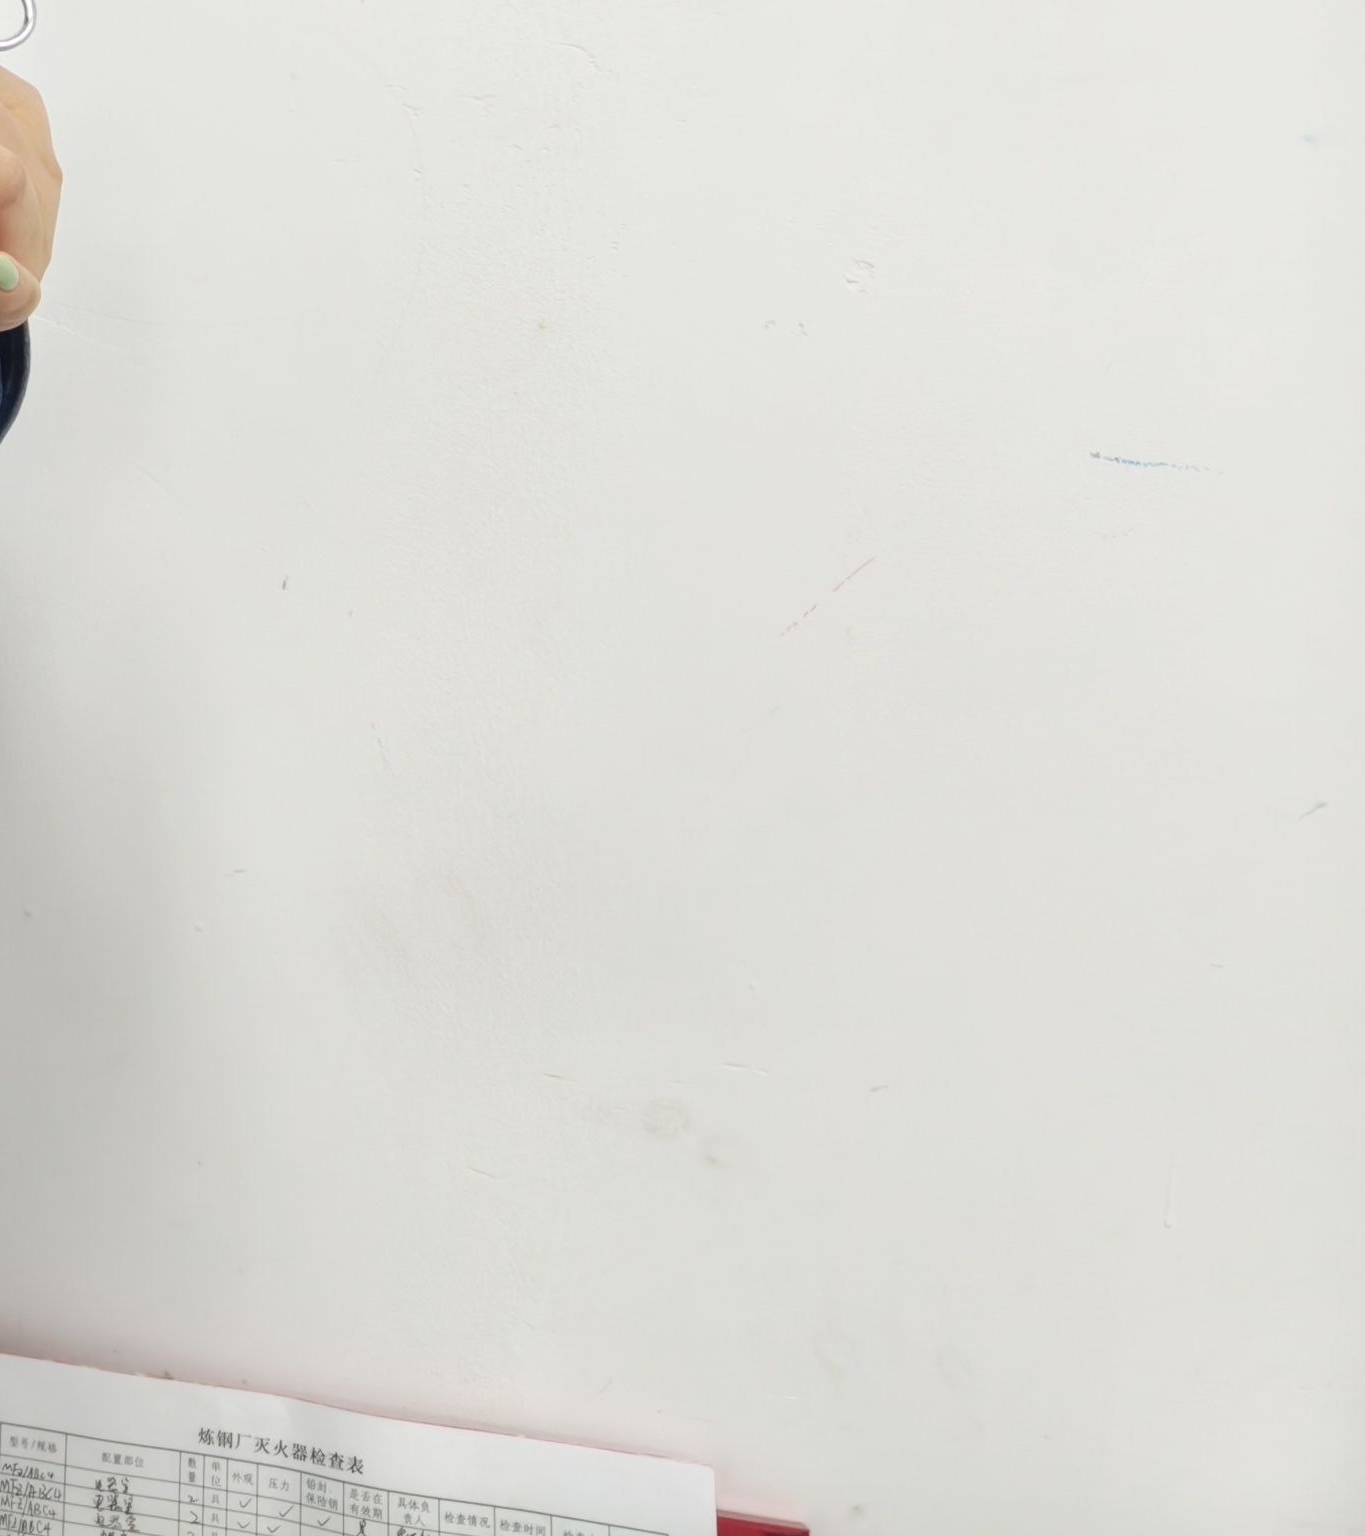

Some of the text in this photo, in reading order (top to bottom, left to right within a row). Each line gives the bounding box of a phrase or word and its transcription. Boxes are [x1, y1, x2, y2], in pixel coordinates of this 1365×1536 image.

[198, 1427, 364, 1475] 炼钢厂灭火器检查表
[232, 1471, 254, 1486] 外观
[268, 1477, 290, 1492] 压力
[444, 1511, 491, 1529] 检查情况
